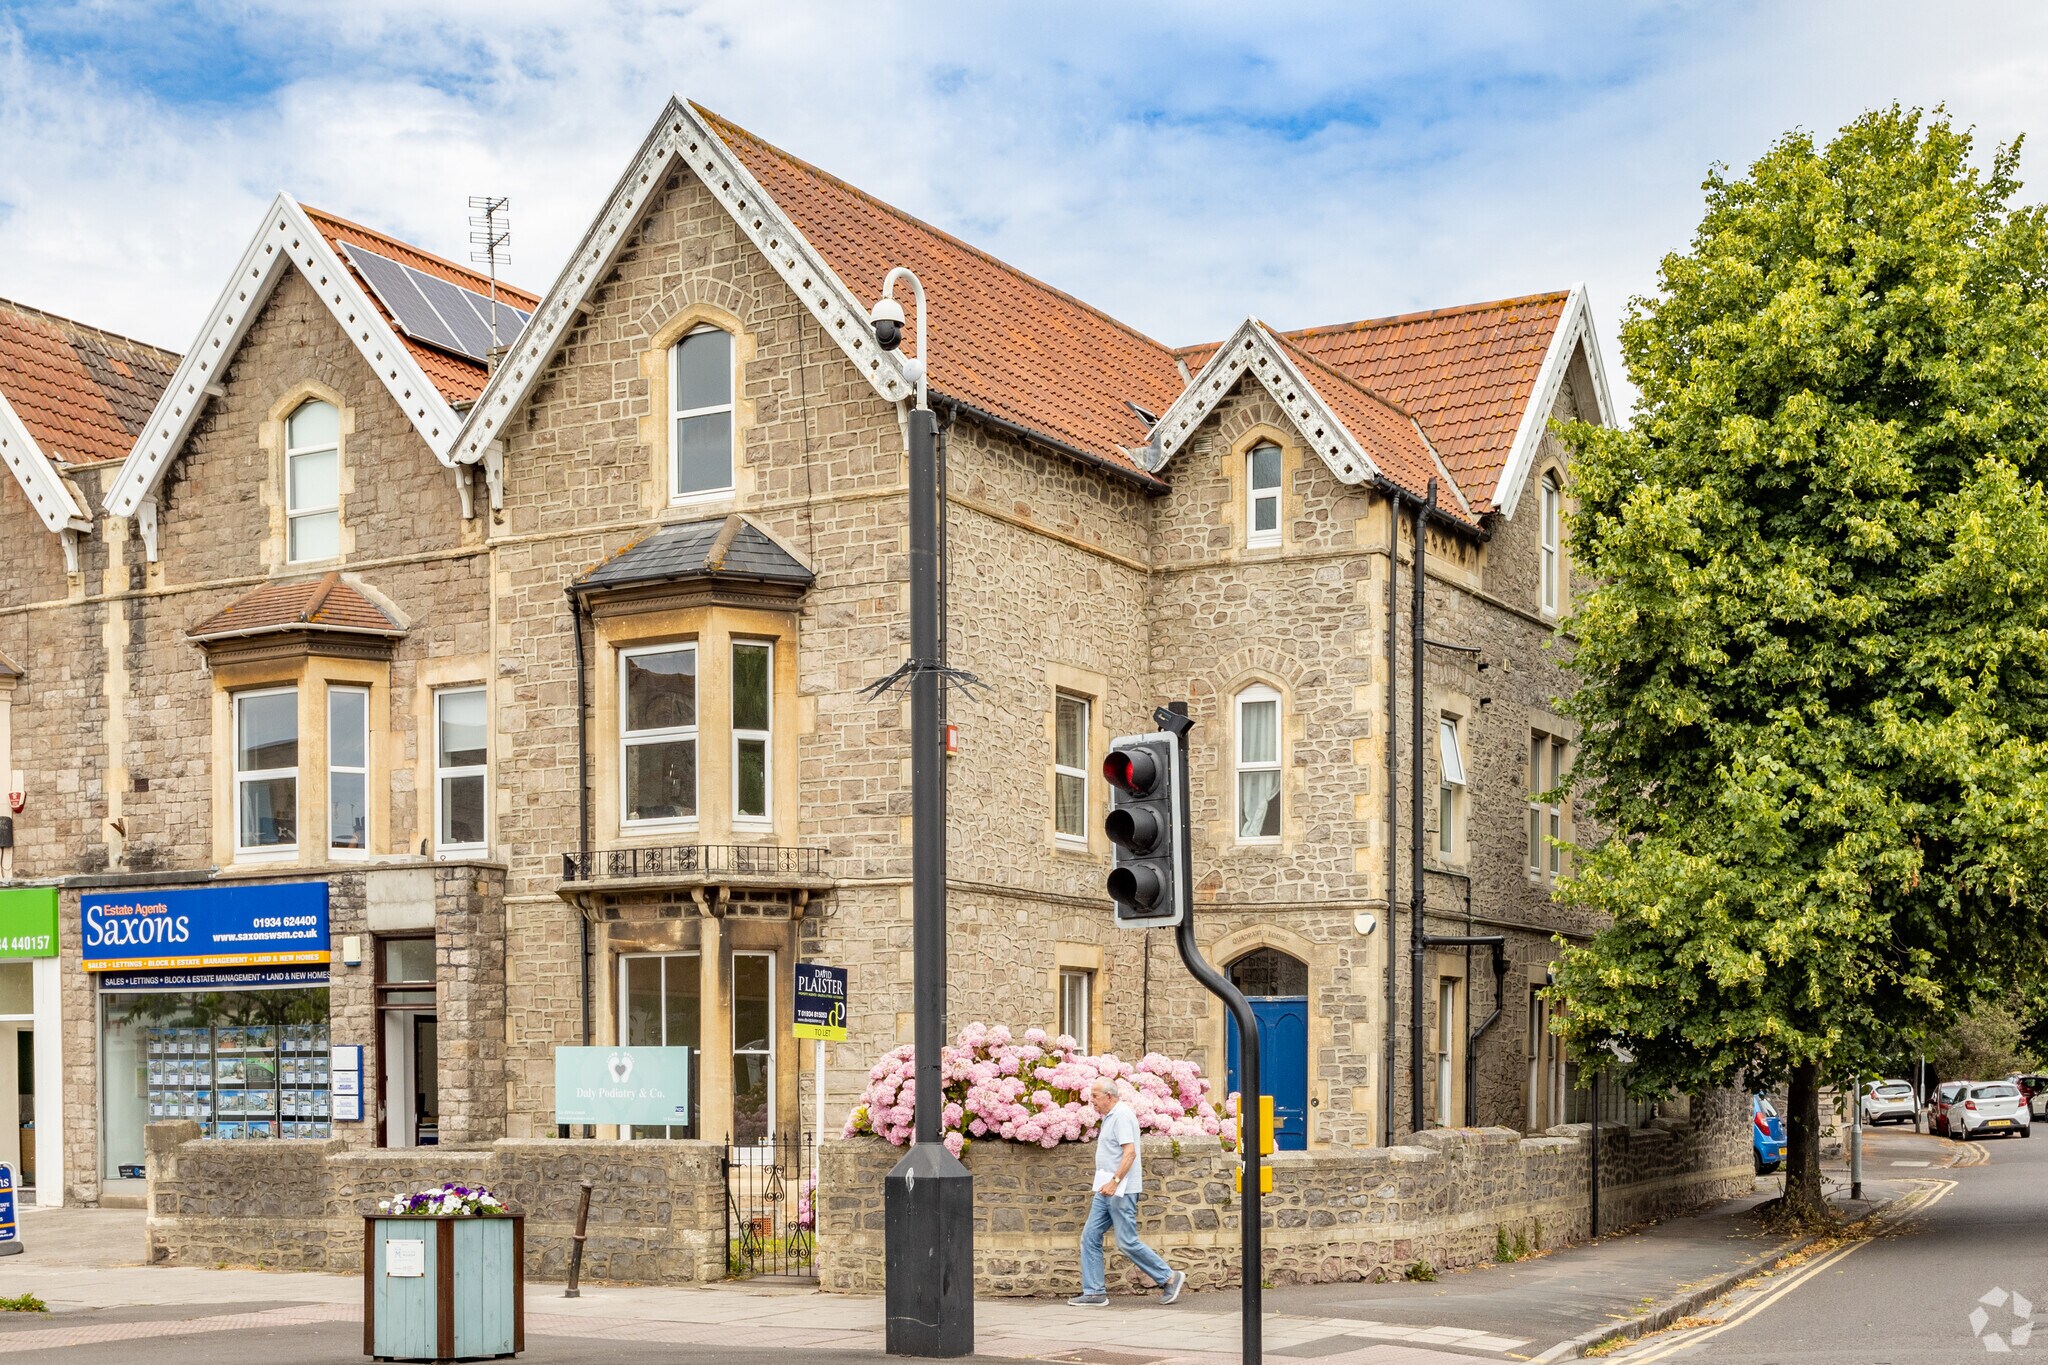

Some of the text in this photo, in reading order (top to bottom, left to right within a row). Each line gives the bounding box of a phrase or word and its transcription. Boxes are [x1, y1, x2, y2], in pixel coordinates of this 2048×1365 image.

[104, 903, 168, 917] Estate Agents
[87, 906, 189, 946] Saxons
[253, 916, 317, 928] 01934 624400
[213, 929, 318, 942] www.saxonswsm.co.uk
[11, 936, 50, 950] 440157
[87, 961, 107, 969] SALES
[112, 960, 142, 968] LETTINGS
[147, 959, 170, 967] BLOCK
[177, 958, 201, 966] ESTATE
[203, 956, 248, 965] MANAGEMENT
[253, 955, 271, 963] LAND
[279, 954, 294, 962] NEW
[296, 953, 319, 961] HOMES
[105, 971, 330, 986] SALES LETTINGS BLOCK & ESTATE MANAGEMENT LAND & NEW HOMES
[815, 969, 832, 979] DAVID
[798, 976, 844, 995] PLAISTER
[823, 1029, 831, 1037] LET
[576, 1087, 665, 1100] Daly Podiatry & Co.
